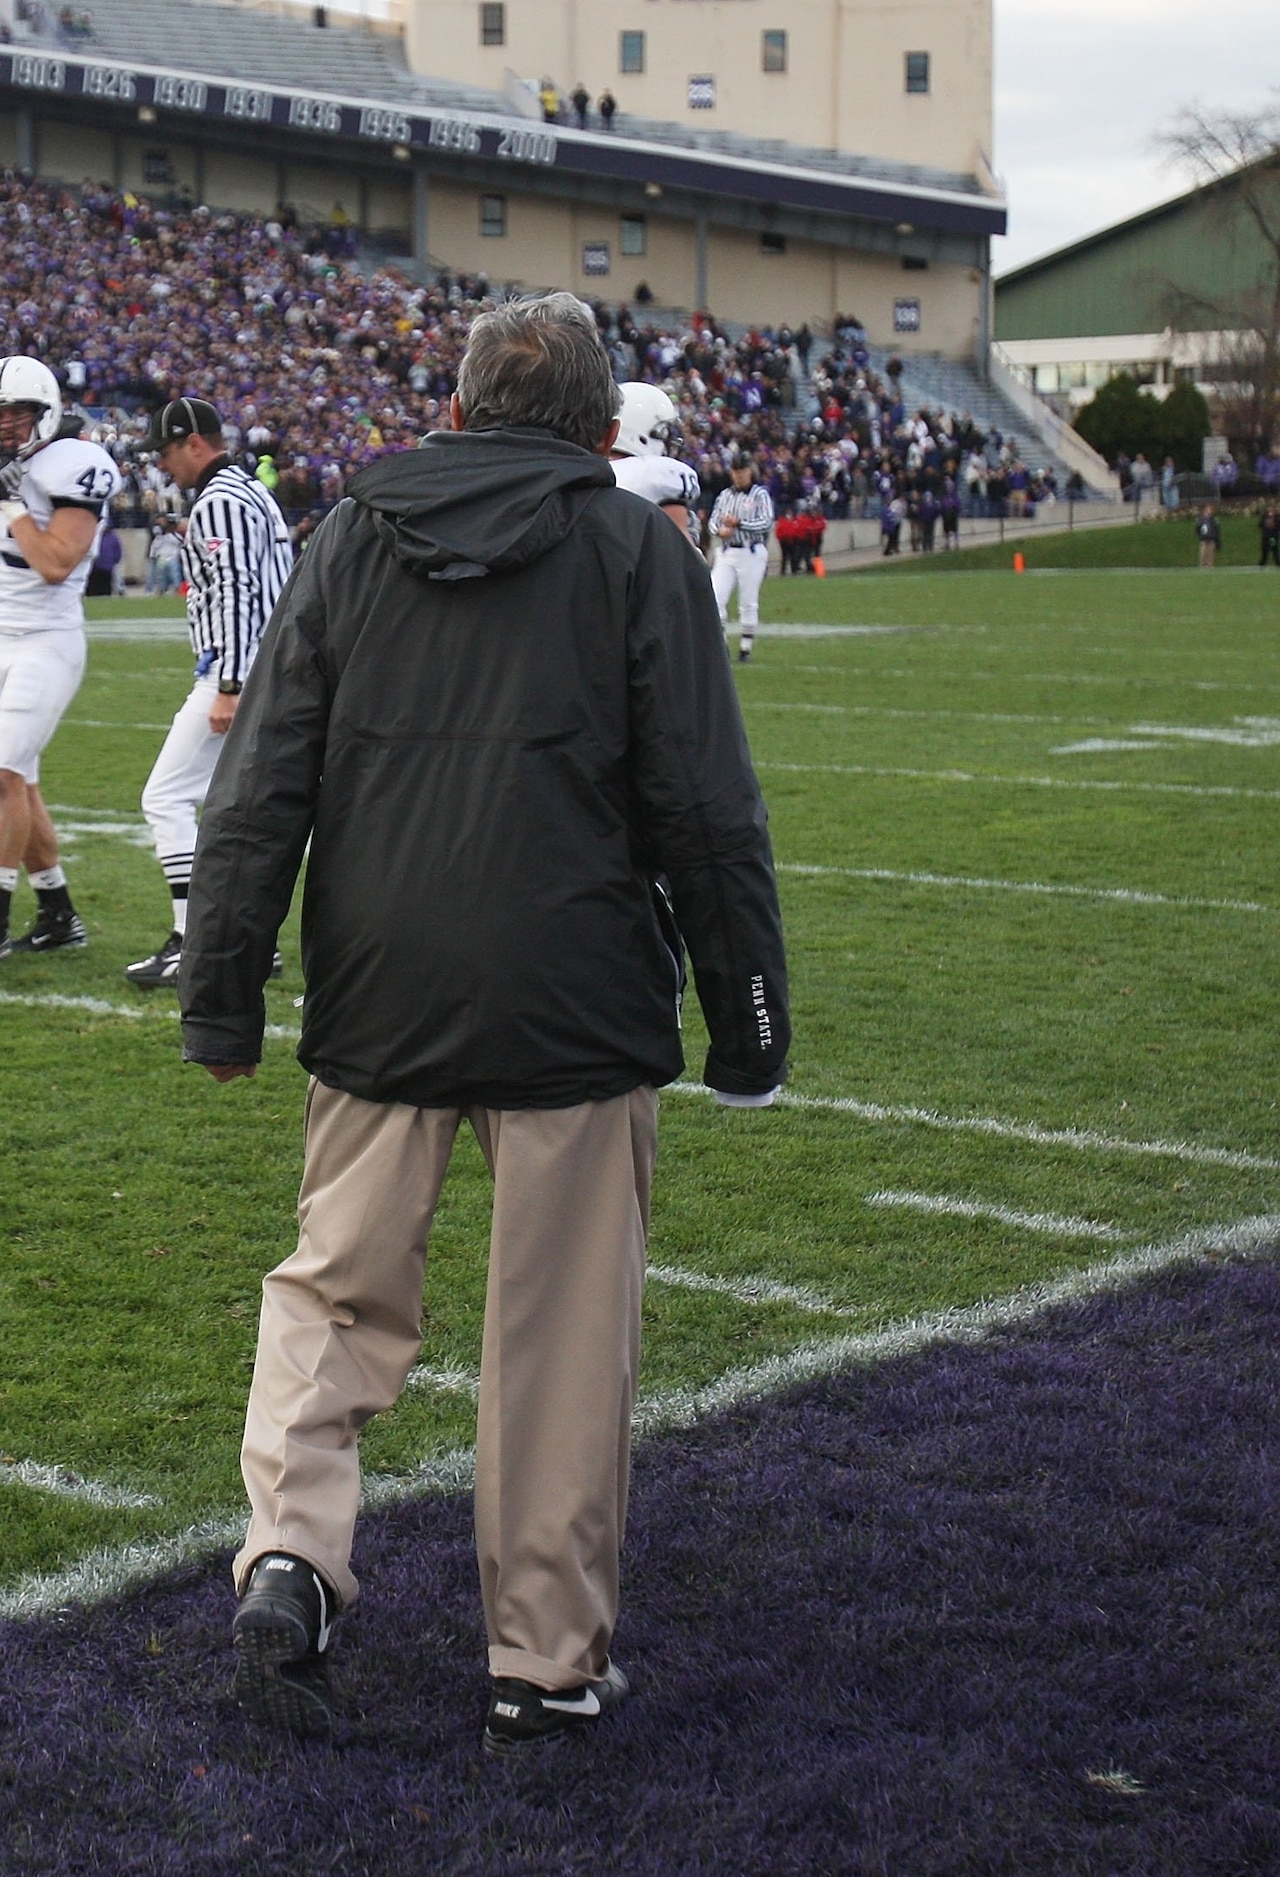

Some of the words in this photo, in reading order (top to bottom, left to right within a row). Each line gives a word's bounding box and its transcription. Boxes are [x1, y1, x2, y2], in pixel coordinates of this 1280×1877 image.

[11, 55, 66, 89] 1903
[83, 65, 137, 102] 1926
[154, 76, 208, 112] 1930
[225, 86, 273, 122] 1931
[289, 96, 341, 133] 1936
[359, 107, 412, 144] 1995
[428, 118, 481, 154] 1996
[497, 129, 557, 164] 2000
[76, 465, 114, 498] 43
[751, 974, 764, 1005] PENN
[756, 1008, 773, 1046] STATE
[265, 1559, 297, 1573] NIKE
[494, 1701, 521, 1719] NIKE
